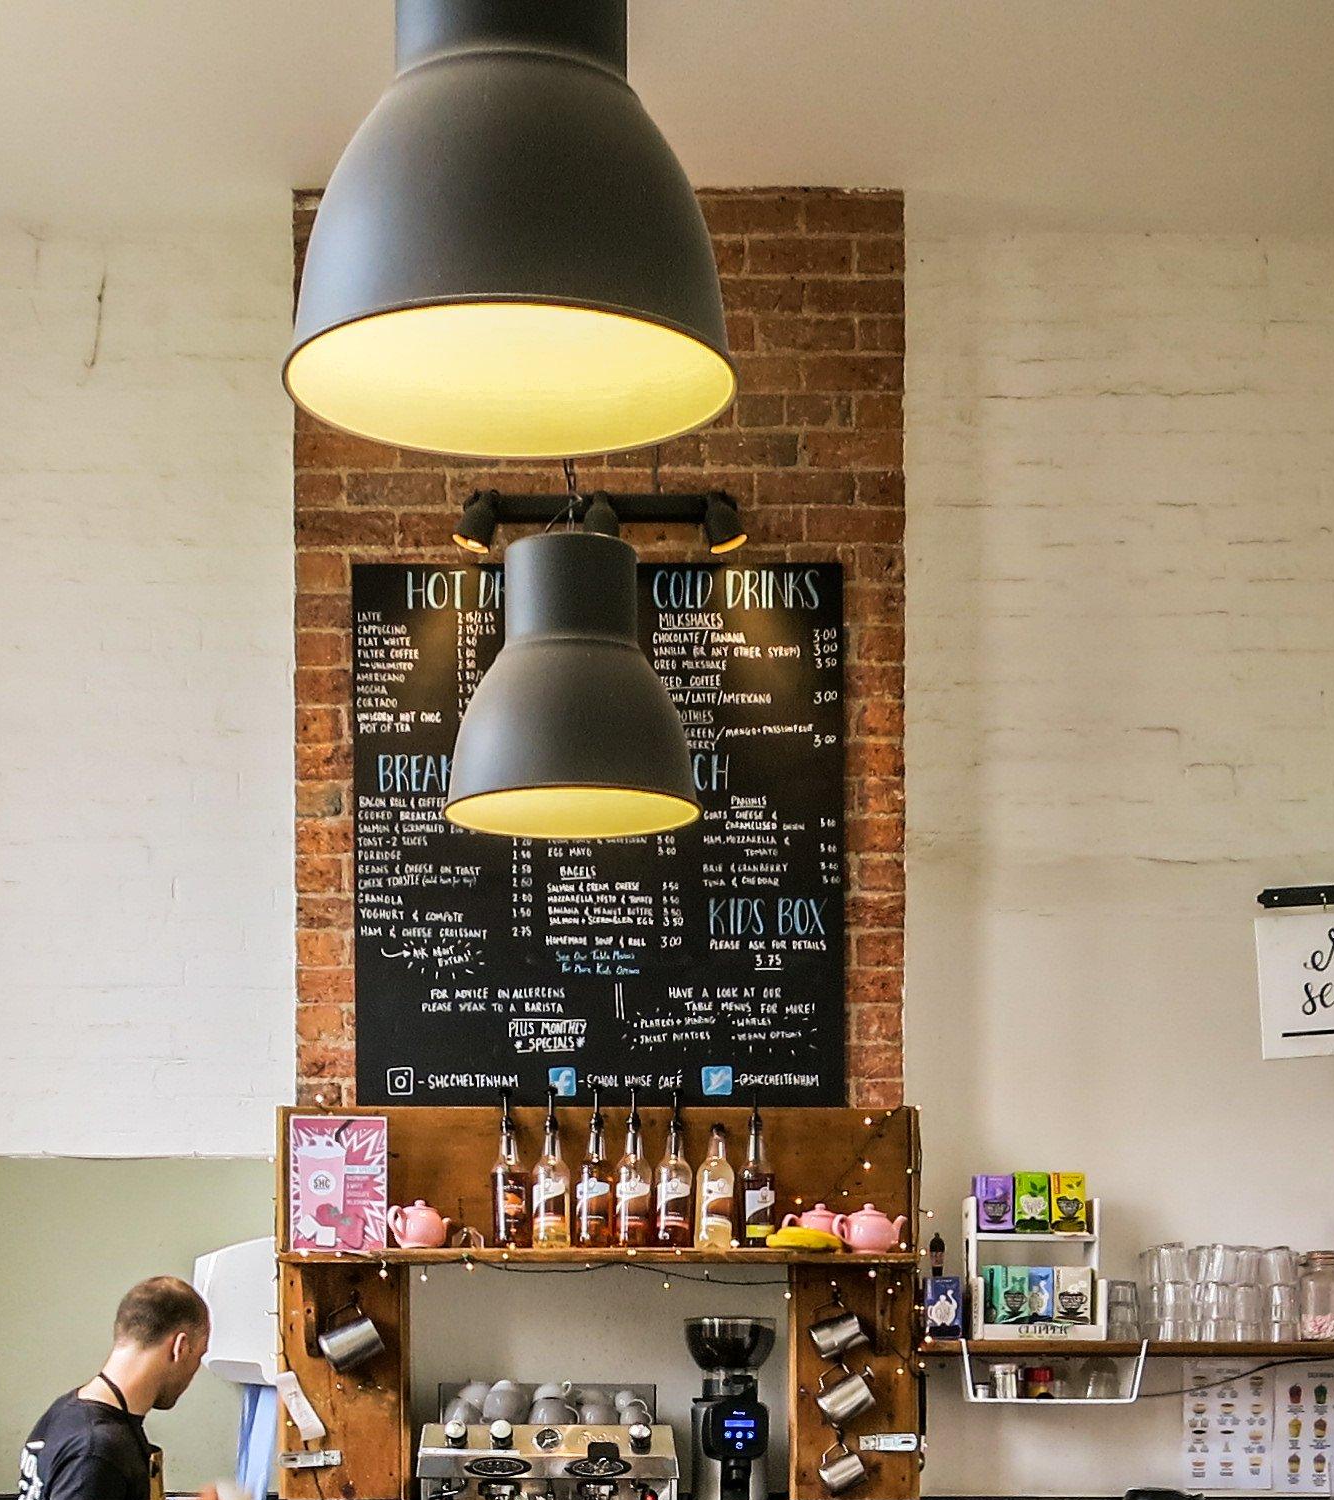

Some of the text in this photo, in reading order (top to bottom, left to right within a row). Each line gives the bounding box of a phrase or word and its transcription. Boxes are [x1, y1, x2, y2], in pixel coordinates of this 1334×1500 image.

[407, 570, 467, 609] HOT
[653, 569, 819, 610] COLD DRINKS
[357, 612, 382, 622] LATTE
[659, 613, 723, 628] MILKSHAKES
[358, 624, 407, 635] CAPPUCCINO
[358, 636, 411, 647] FLAT WHITE
[653, 632, 746, 645] CHOCOLATE BANANA
[358, 648, 419, 660] FILTER COFFEE
[653, 646, 687, 657] VANILLA
[711, 646, 728, 657] ANY
[733, 646, 762, 659] OTHER
[371, 662, 414, 671] UNLIMITED
[682, 659, 727, 671] MILKSHAKE
[357, 672, 405, 683] AMERICANO
[689, 674, 722, 687] COFFEE
[357, 684, 388, 696] MOCHA
[357, 698, 398, 708] CORTADO
[357, 711, 442, 724] UNICORN HOT CHOC
[360, 723, 412, 734] POT OF TEA
[358, 796, 386, 808] BACON
[389, 796, 407, 808] ROLL
[730, 796, 767, 809] PANINIS
[358, 810, 393, 821] COOKED
[703, 810, 764, 820] GOATS CHEESE
[358, 823, 445, 834] SALMON SCRAMBLED
[725, 820, 778, 831] CARAMELISED
[357, 836, 428, 847] TOAST SLICES
[358, 850, 402, 861] PORRIDGE
[547, 847, 593, 858] EGG MAYO
[744, 848, 779, 857] TOMATO
[358, 863, 482, 876] BEANS CHEESE ON TOAST
[559, 865, 597, 879] BAGELS
[702, 862, 789, 874] BRIE CRANBERRY
[387, 874, 419, 886] TOASTIE
[702, 876, 780, 888] TUNA CHEDDAR
[547, 881, 640, 893] SALMON CREAM CHEESE
[357, 894, 404, 905] GRANOLA
[628, 895, 653, 905] TOMATO
[359, 908, 464, 923] YOGHURT COMPOTE
[548, 906, 654, 917] BANANA PEANUT BUTTER
[708, 897, 828, 936] KIDS BOX
[549, 916, 580, 926] SALMON
[587, 915, 634, 926] SCRAMBLED
[360, 926, 382, 937] HAM
[402, 927, 433, 938] CHEESE
[439, 928, 488, 940] CROISSANT
[545, 935, 646, 947] HOMEMADE SOUP ROLL
[709, 938, 827, 951] PLEASE ASK FOR DETAILS
[413, 945, 455, 960] ASK ABOUT
[430, 986, 565, 999] FOR ADVICE ON ALLERGENS
[669, 987, 782, 999] HAVE A LOOK AT OUR
[421, 1002, 564, 1014] PLEASE SPEAK TO A BARISTA
[684, 1000, 815, 1014] TABLE MENUS FOR MORE!
[508, 1020, 587, 1037] PLUS MONTHLY
[639, 1031, 710, 1044] JACKET POTATOES
[737, 1030, 801, 1042] VEGAN OPTIONS
[624, 1074, 652, 1088] HOUSE
[658, 1069, 683, 1089] CAFÉ
[313, 1178, 331, 1189] SHC
